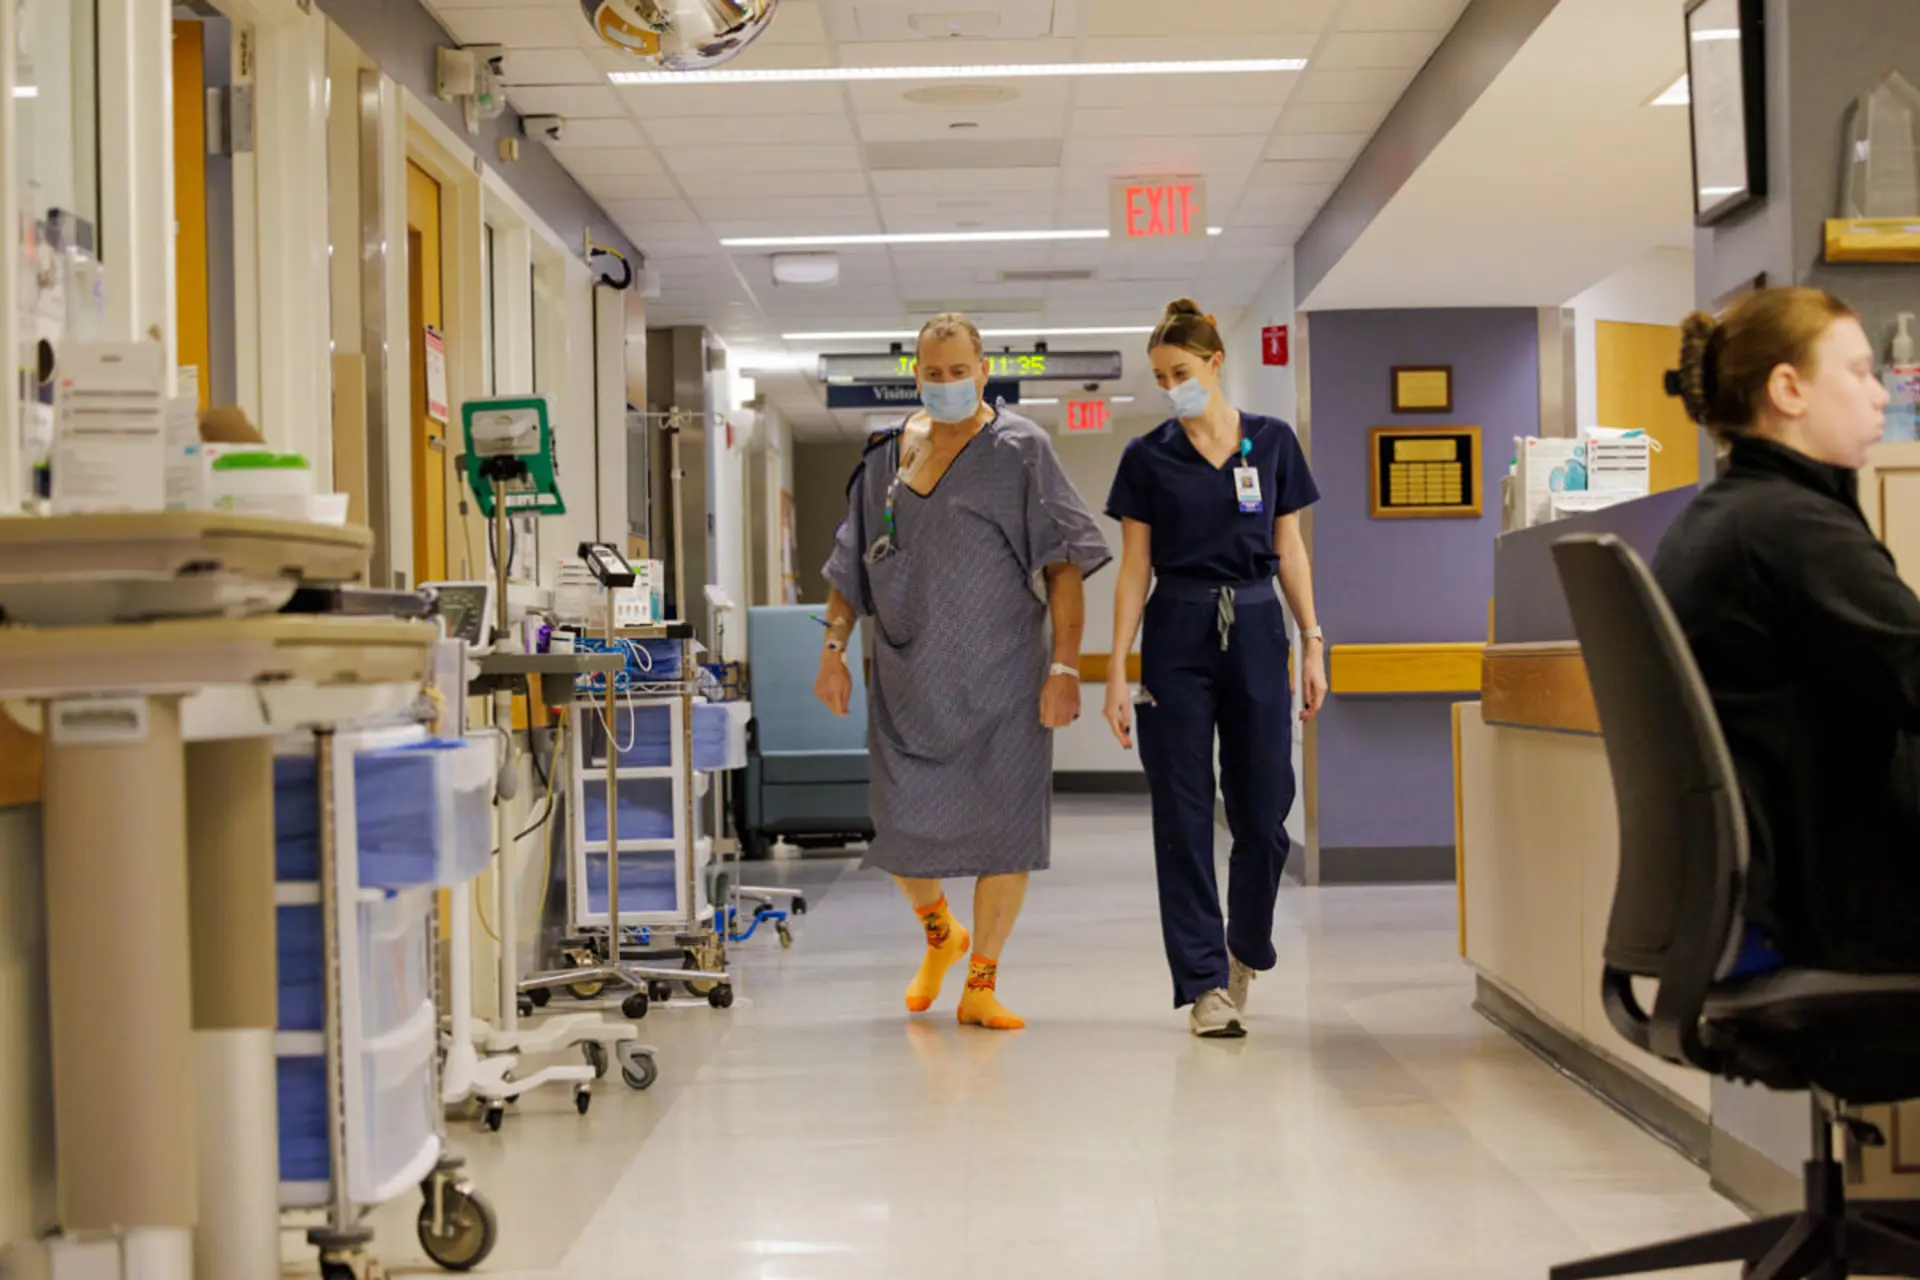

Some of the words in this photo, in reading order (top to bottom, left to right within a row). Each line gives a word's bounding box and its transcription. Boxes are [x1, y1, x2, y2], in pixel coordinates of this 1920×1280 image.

[1125, 185, 1195, 237] EXIT
[988, 355, 1046, 376] 11:35
[1066, 400, 1104, 431] EXIT
